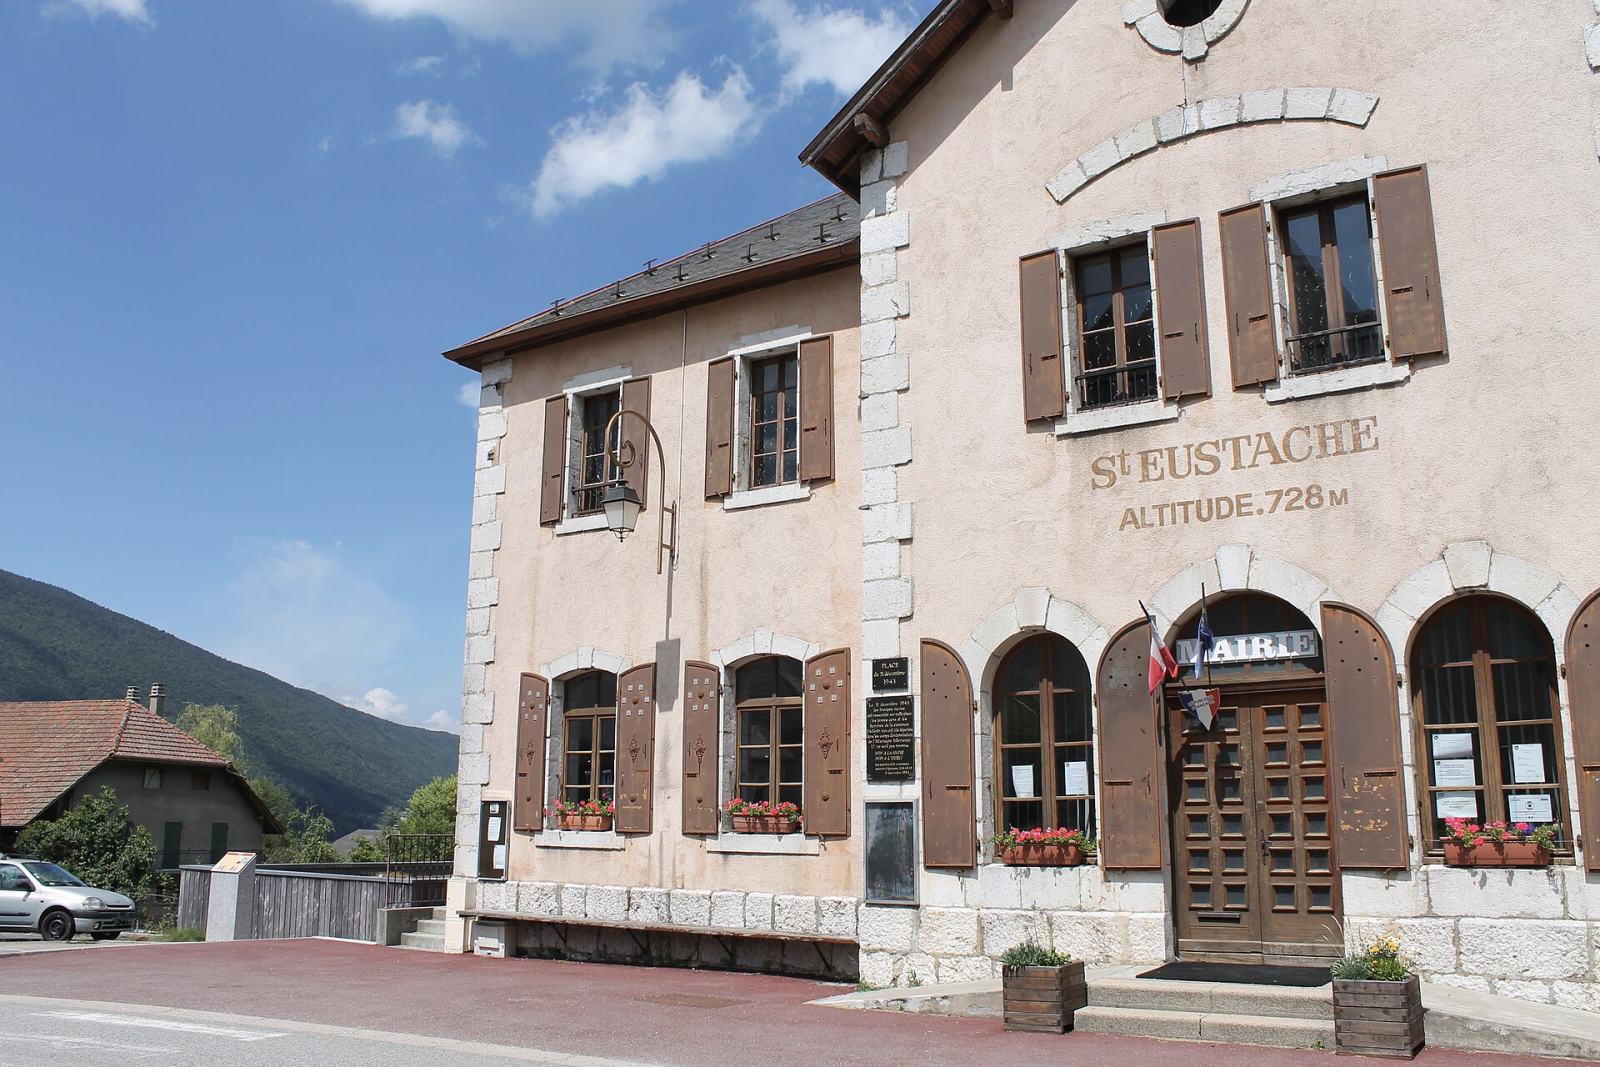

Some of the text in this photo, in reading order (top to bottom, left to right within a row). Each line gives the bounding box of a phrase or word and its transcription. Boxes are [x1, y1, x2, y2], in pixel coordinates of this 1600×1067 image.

[1091, 415, 1379, 490] St EUSTACHE
[1176, 634, 1315, 664] MAIRIE
